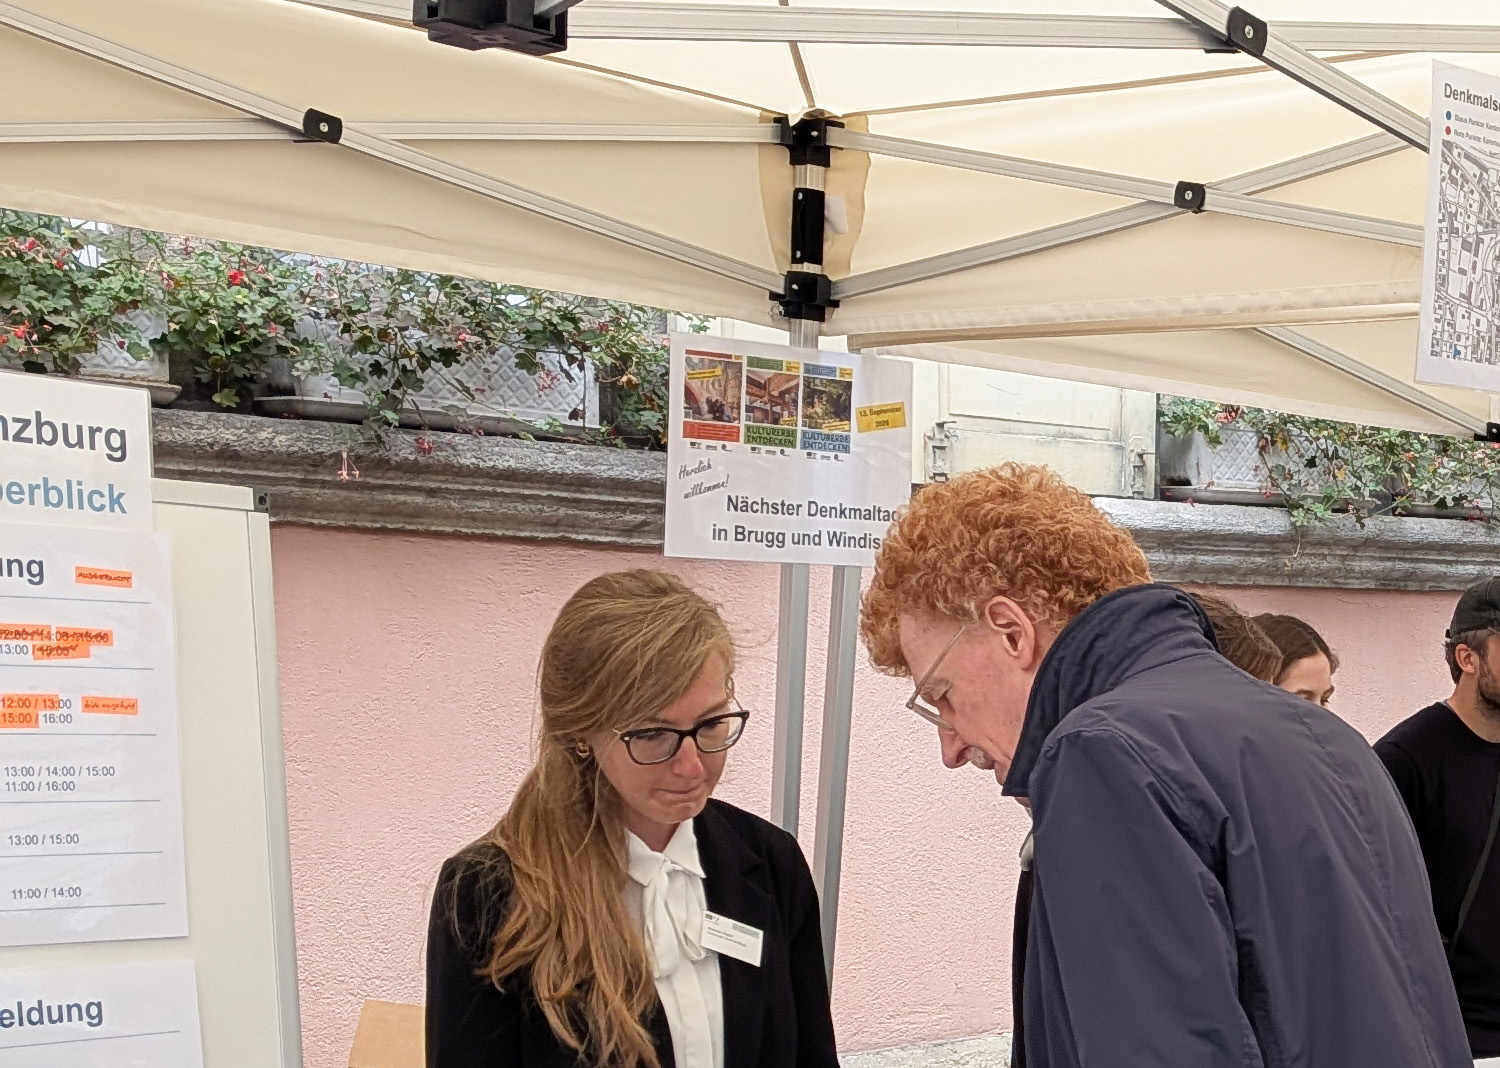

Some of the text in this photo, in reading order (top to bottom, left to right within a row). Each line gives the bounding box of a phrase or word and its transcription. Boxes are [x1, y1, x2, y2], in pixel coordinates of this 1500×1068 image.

[0, 477, 127, 514] erblick
[726, 494, 803, 517] Nächster
[712, 523, 728, 541] in
[734, 524, 786, 549] Brugg
[791, 529, 822, 547] und
[1, 697, 32, 709] 12:00
[42, 698, 72, 710] 13:00
[2, 712, 33, 724] 15:00
[42, 713, 73, 724] 16:00
[4, 766, 35, 777] 13:00
[45, 766, 76, 777] 14:00
[86, 765, 116, 777] 15:00
[5, 781, 35, 792] 11:00
[45, 780, 76, 792] 16:00
[8, 834, 39, 846] 13:00
[49, 833, 80, 845] 15:00
[11, 888, 42, 900] 11:00
[51, 886, 82, 898] 14:00
